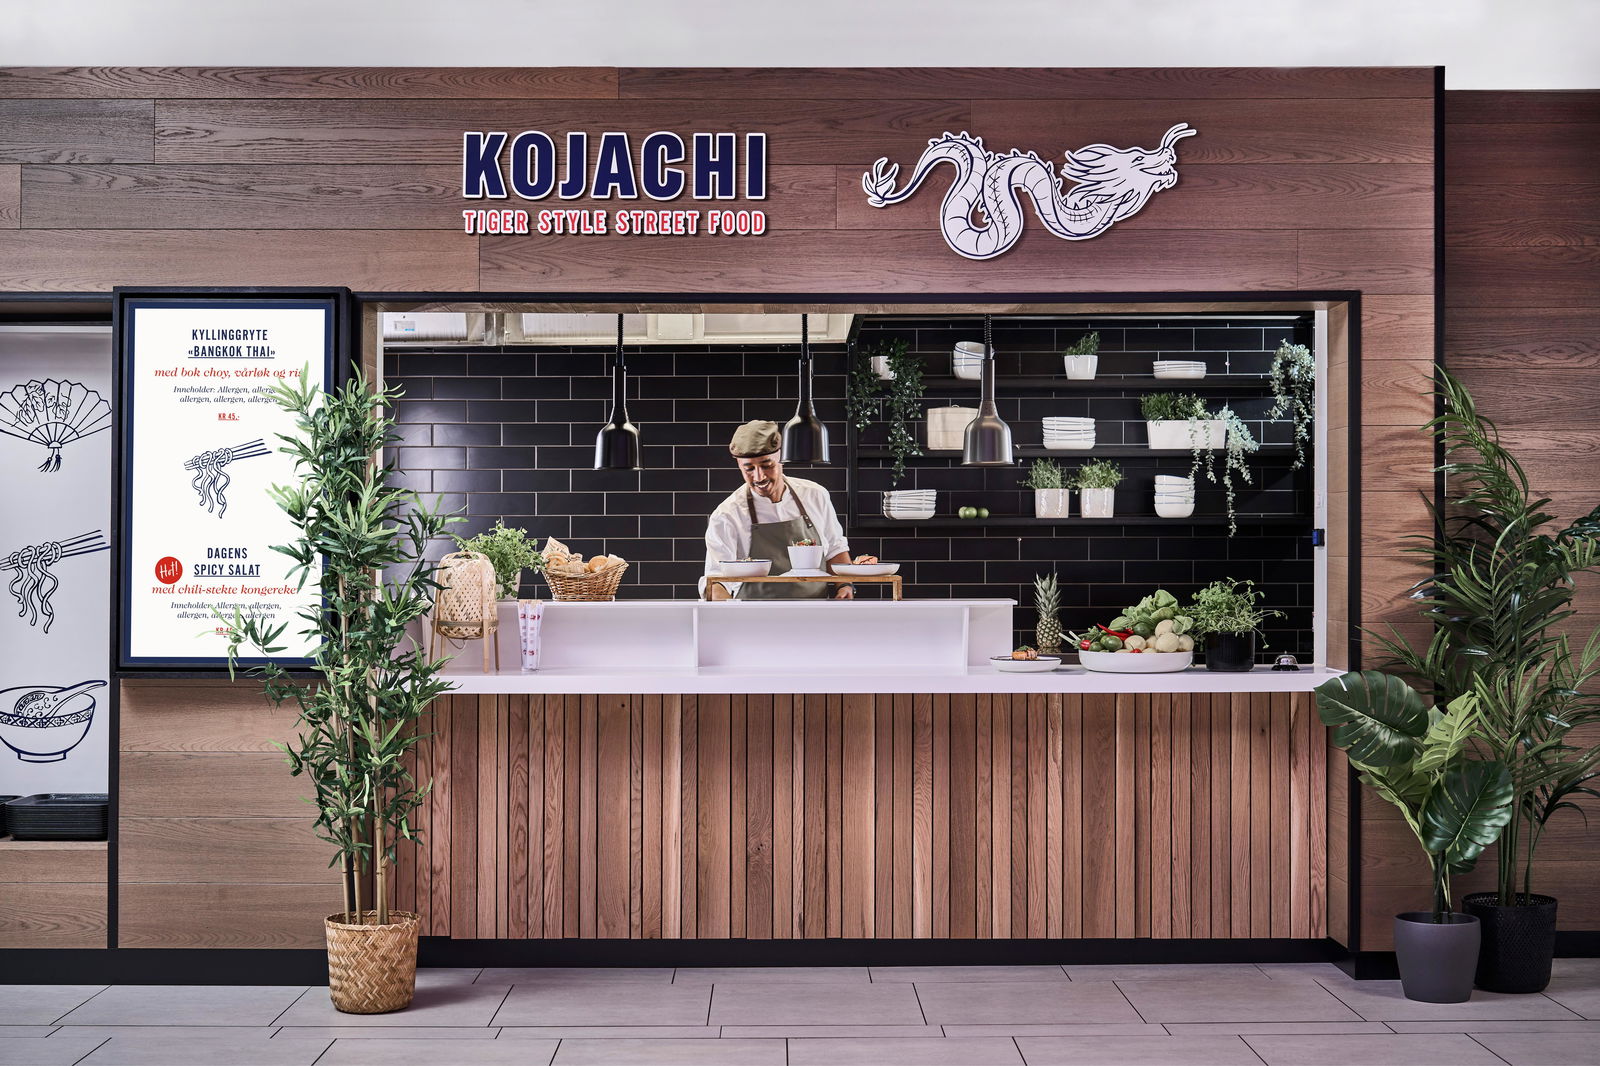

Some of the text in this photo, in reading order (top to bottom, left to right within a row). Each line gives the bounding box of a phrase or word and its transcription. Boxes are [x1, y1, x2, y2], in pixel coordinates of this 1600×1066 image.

[463, 131, 767, 200] KOJACHI
[463, 210, 766, 235] TIGER STYLE STREET FOOD
[192, 329, 268, 340] KYLLINGGRYTE
[188, 346, 275, 357] «BANGKOK THAI»
[155, 367, 178, 377] med
[181, 367, 200, 377] bok
[204, 368, 230, 379] choy,
[234, 368, 270, 377] vårløk
[273, 369, 285, 380] og
[217, 386, 249, 394] Allergen,
[218, 412, 226, 421] KR
[207, 548, 247, 559] DAGENS
[159, 561, 179, 578] Hot!
[194, 564, 260, 575] SPICY SALAT
[151, 584, 176, 594] med
[178, 584, 237, 594] chili-stekte
